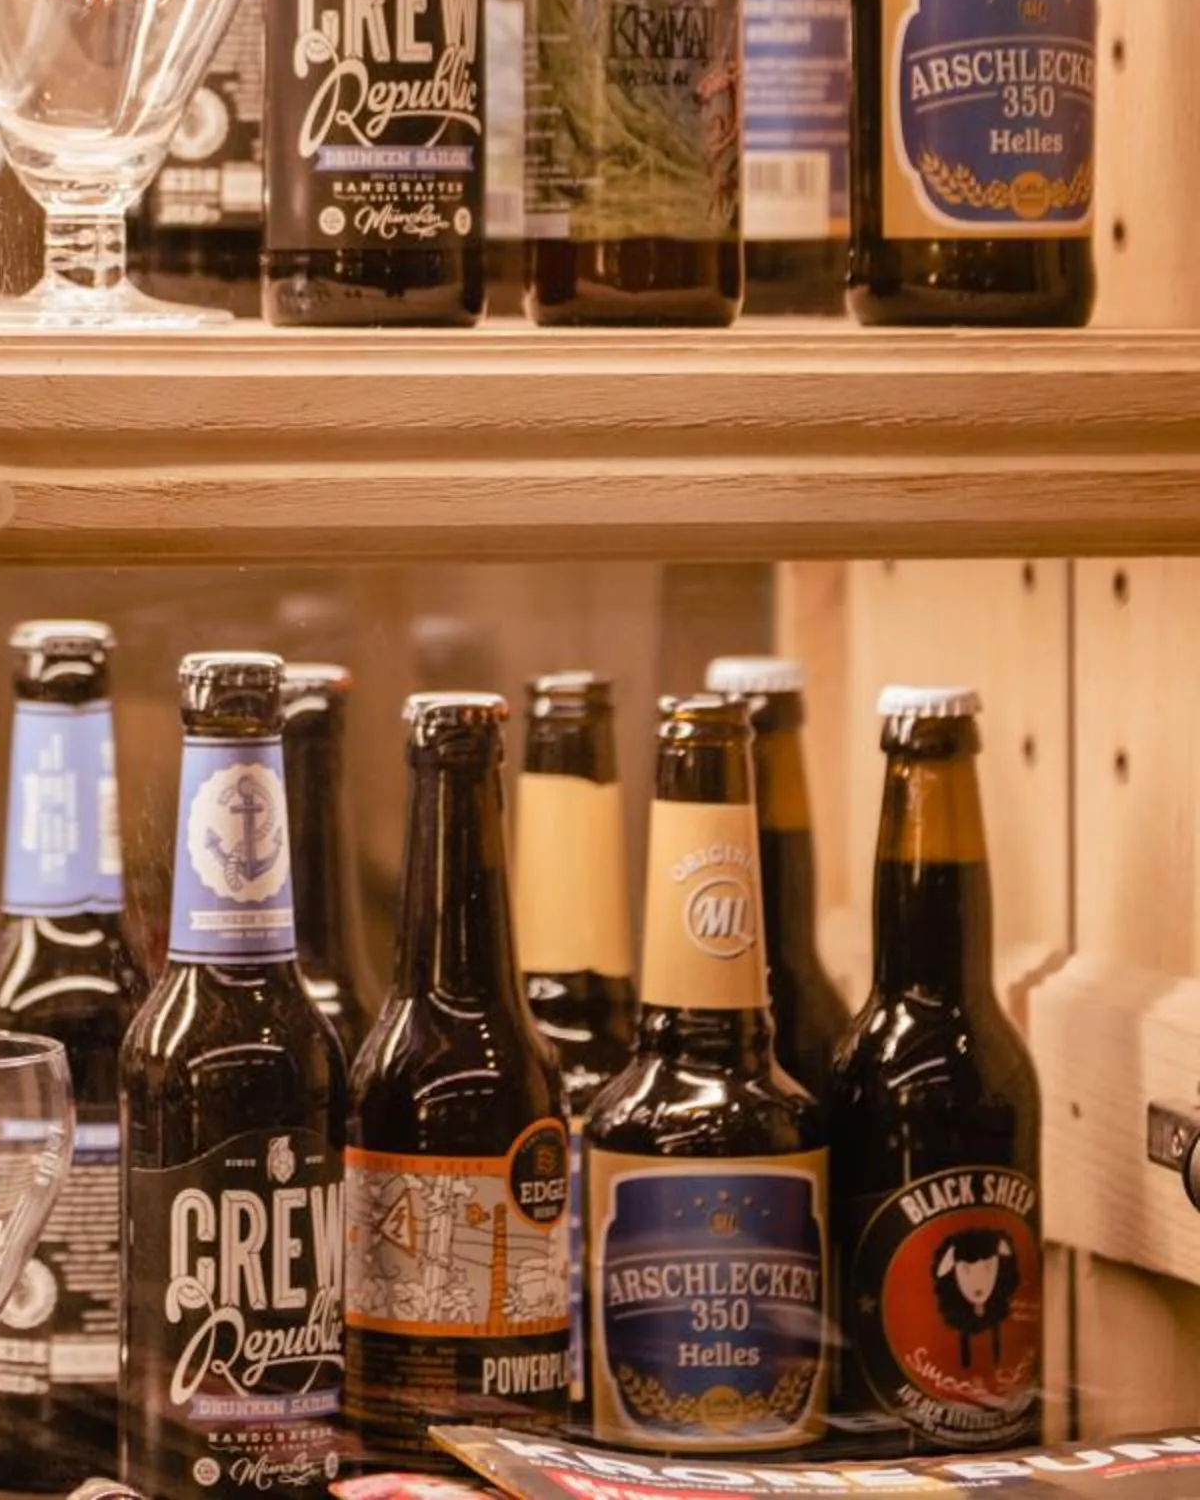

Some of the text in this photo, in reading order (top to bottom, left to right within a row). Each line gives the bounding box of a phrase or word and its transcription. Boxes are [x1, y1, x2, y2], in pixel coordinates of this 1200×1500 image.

[293, 30, 483, 160] Republic
[910, 49, 1095, 101] ARSCHLECKE
[1002, 86, 1056, 120] 350
[989, 128, 1065, 155] Helles
[901, 1174, 976, 1225] BLACK
[169, 1181, 347, 1310] CREW
[608, 1260, 819, 1306] ARSCHLECKEN
[691, 1298, 750, 1333] 350
[678, 1343, 761, 1368] Helles
[199, 1399, 285, 1416] DRUNKEN
[495, 1437, 948, 1489] KRONE
